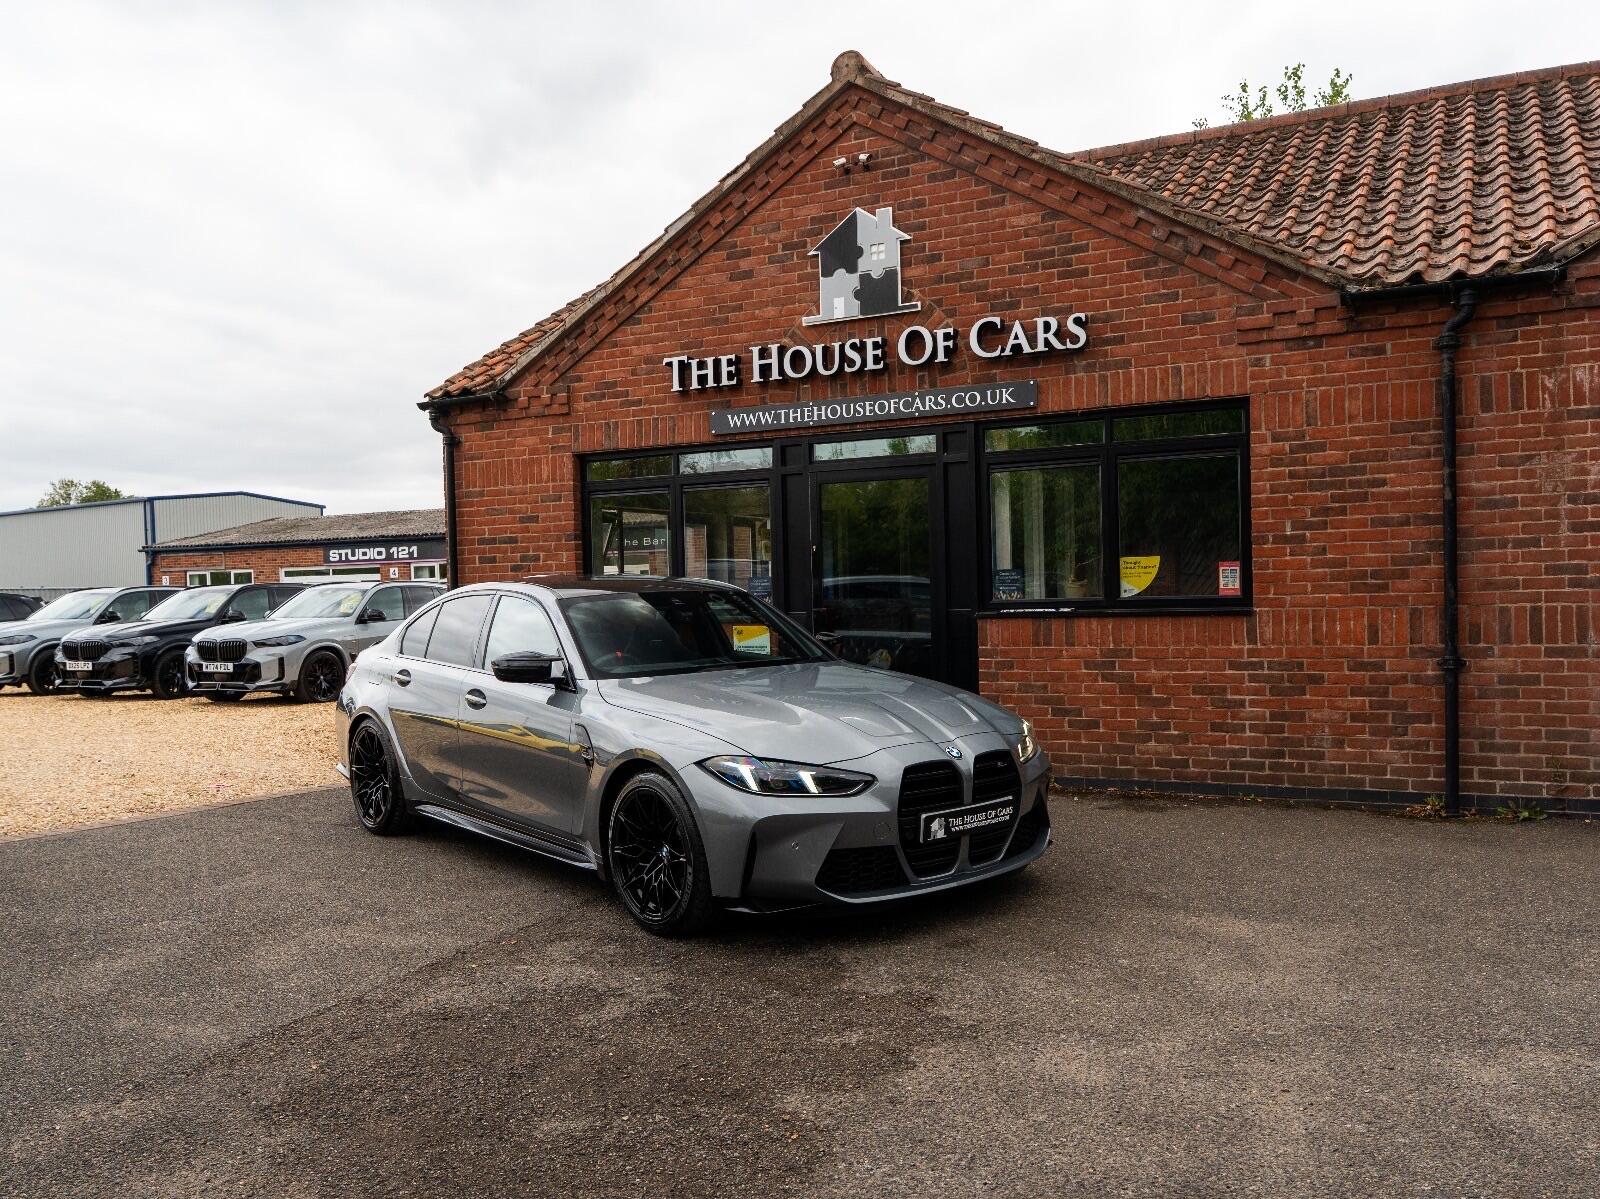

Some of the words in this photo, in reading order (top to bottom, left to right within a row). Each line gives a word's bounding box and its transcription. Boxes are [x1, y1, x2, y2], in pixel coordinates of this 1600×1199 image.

[663, 354, 738, 392] THE
[750, 336, 885, 383] HOUSE
[897, 325, 955, 367] OF
[970, 312, 1088, 359] CARS
[726, 387, 1016, 429] WWW.THEHOUSEOFCARS.CO.UK
[643, 537, 666, 546] Bar
[329, 547, 386, 562] STUDIO
[389, 545, 418, 559] 121
[948, 818, 963, 827] THE
[964, 812, 987, 824] HOUSE
[987, 810, 997, 819] OF
